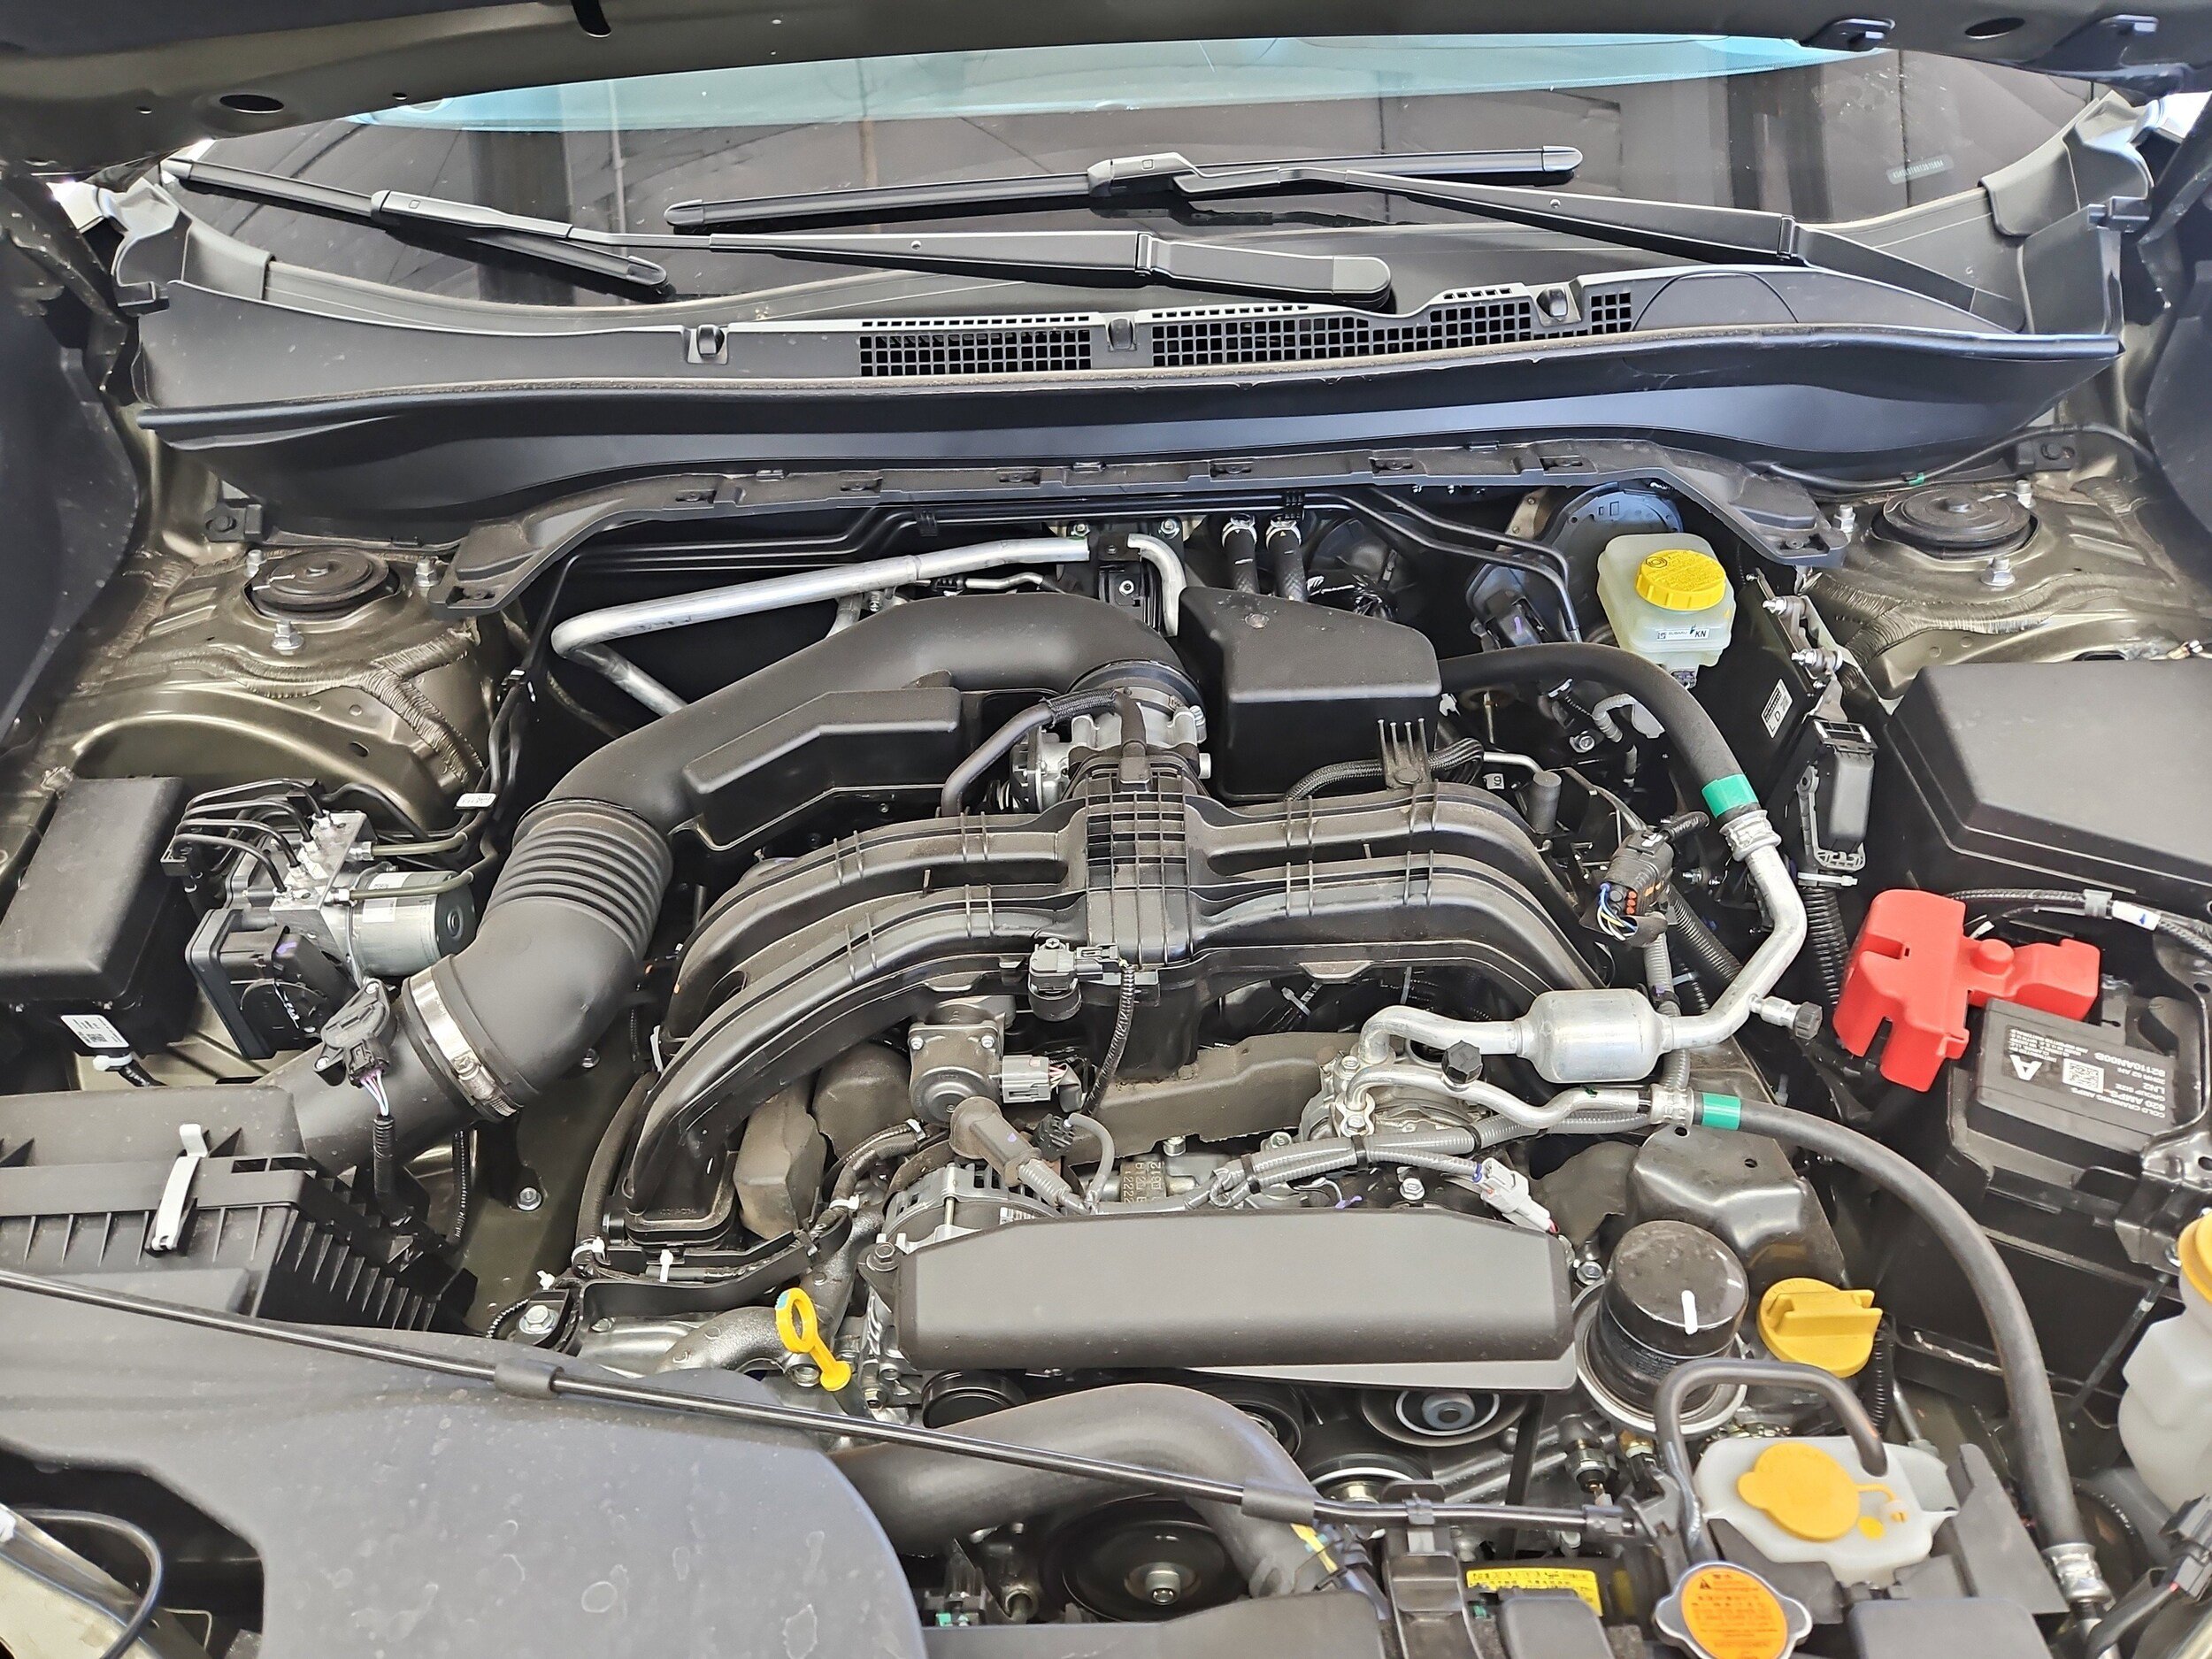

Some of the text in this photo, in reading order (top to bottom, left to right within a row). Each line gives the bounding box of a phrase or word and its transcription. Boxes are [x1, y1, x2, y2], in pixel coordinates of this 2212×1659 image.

[2115, 1083, 2166, 1102] GROUP SIZE
[2142, 1082, 2166, 1094] LN2
[2070, 1087, 2165, 1118] COLD CRANKING AMPS
[2110, 1090, 2166, 1111] 620 AMPS
[1640, 1348, 1678, 1364] CAUTION
